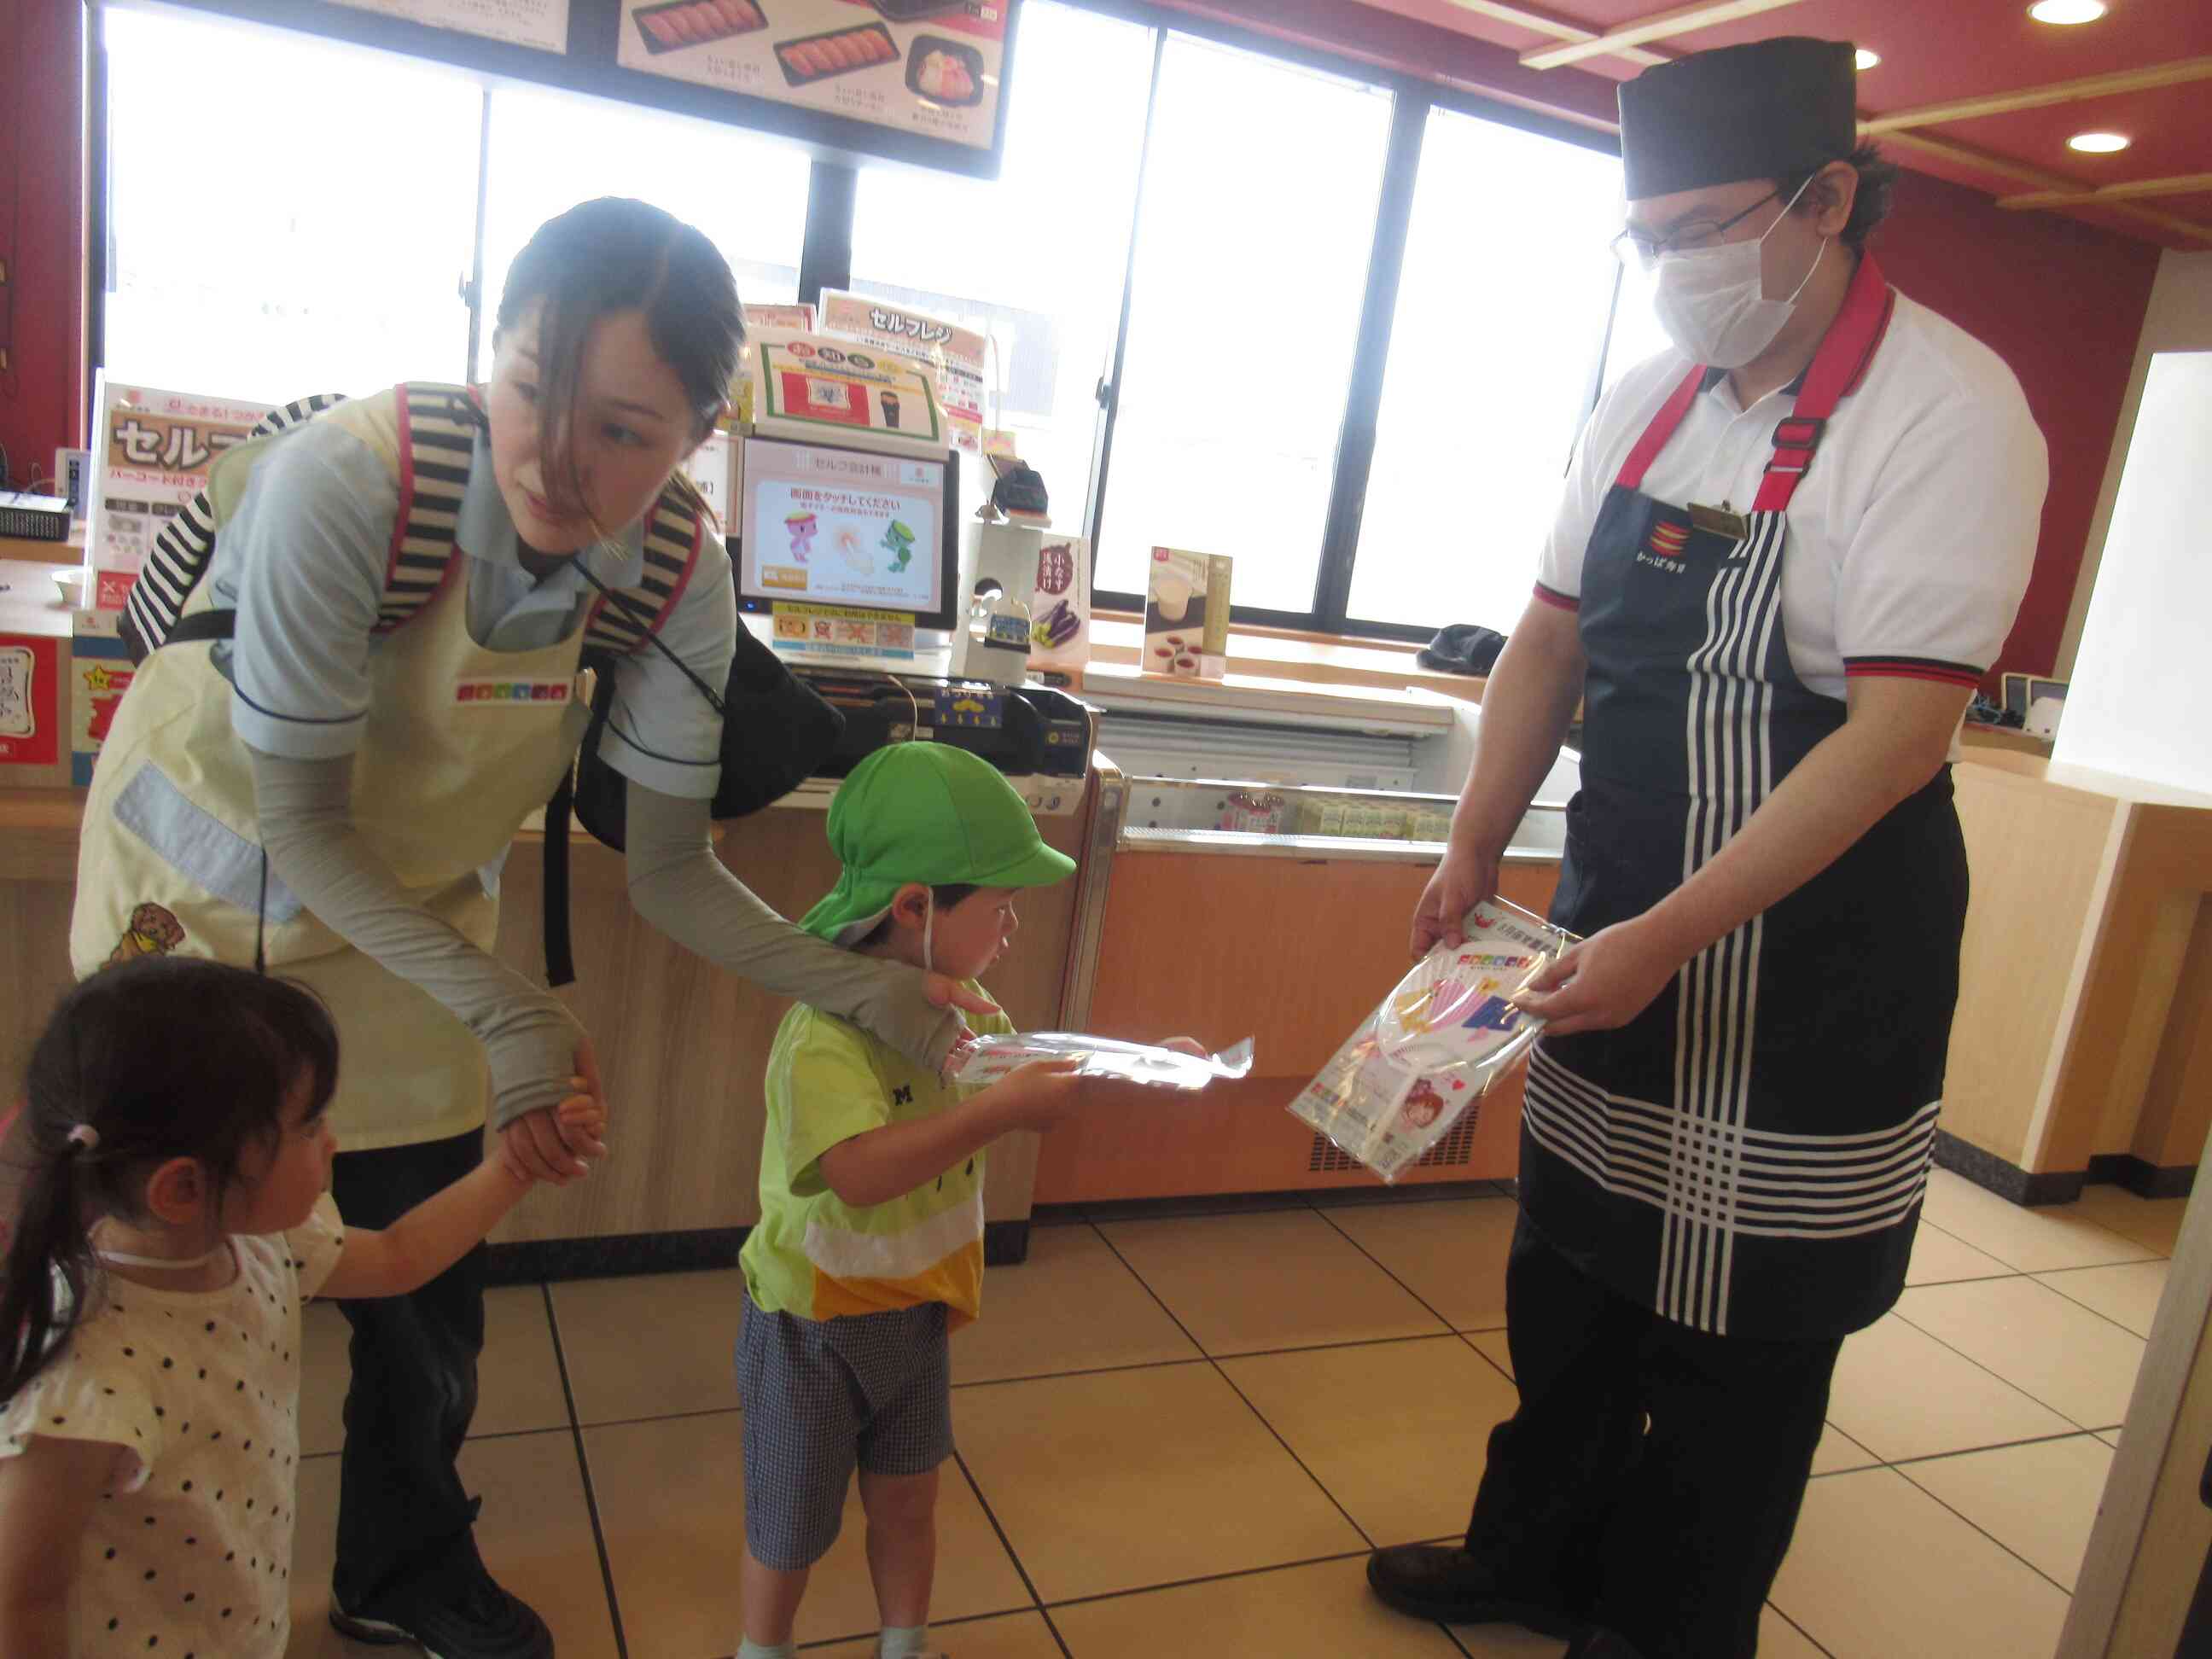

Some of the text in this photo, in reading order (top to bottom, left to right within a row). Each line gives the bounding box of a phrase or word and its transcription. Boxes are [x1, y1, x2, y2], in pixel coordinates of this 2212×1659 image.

[869, 306, 953, 343] セルフレジ
